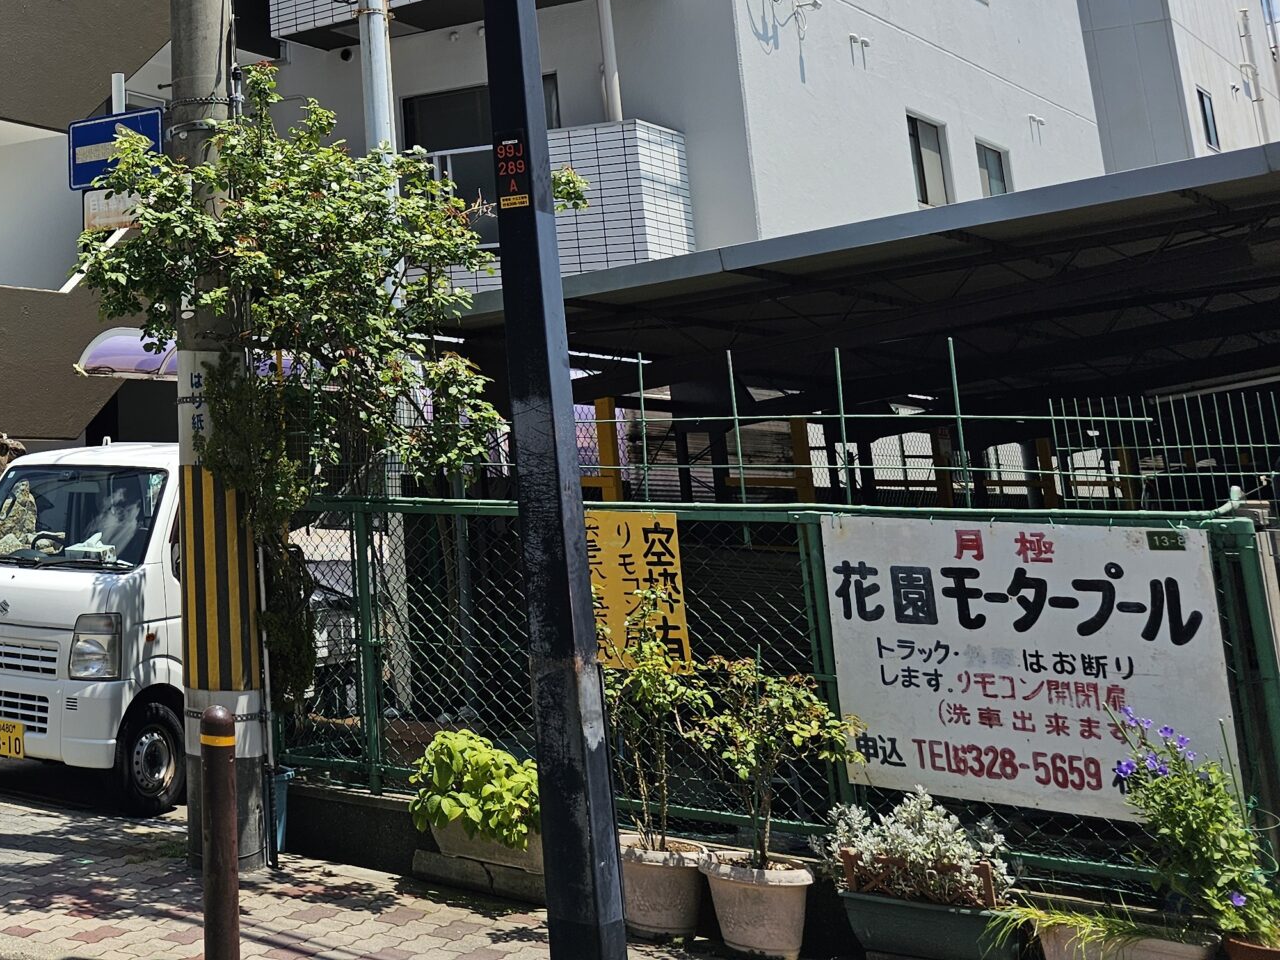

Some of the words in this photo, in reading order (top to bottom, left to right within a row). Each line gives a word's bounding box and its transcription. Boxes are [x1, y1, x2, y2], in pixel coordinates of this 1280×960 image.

[497, 143, 524, 158] 99J
[498, 160, 525, 176] 289
[509, 178, 518, 192] A
[954, 529, 1055, 563] 月極
[833, 560, 1203, 646] 花園モータープール
[1022, 649, 1134, 680] はお断り
[855, 732, 907, 767] 申込
